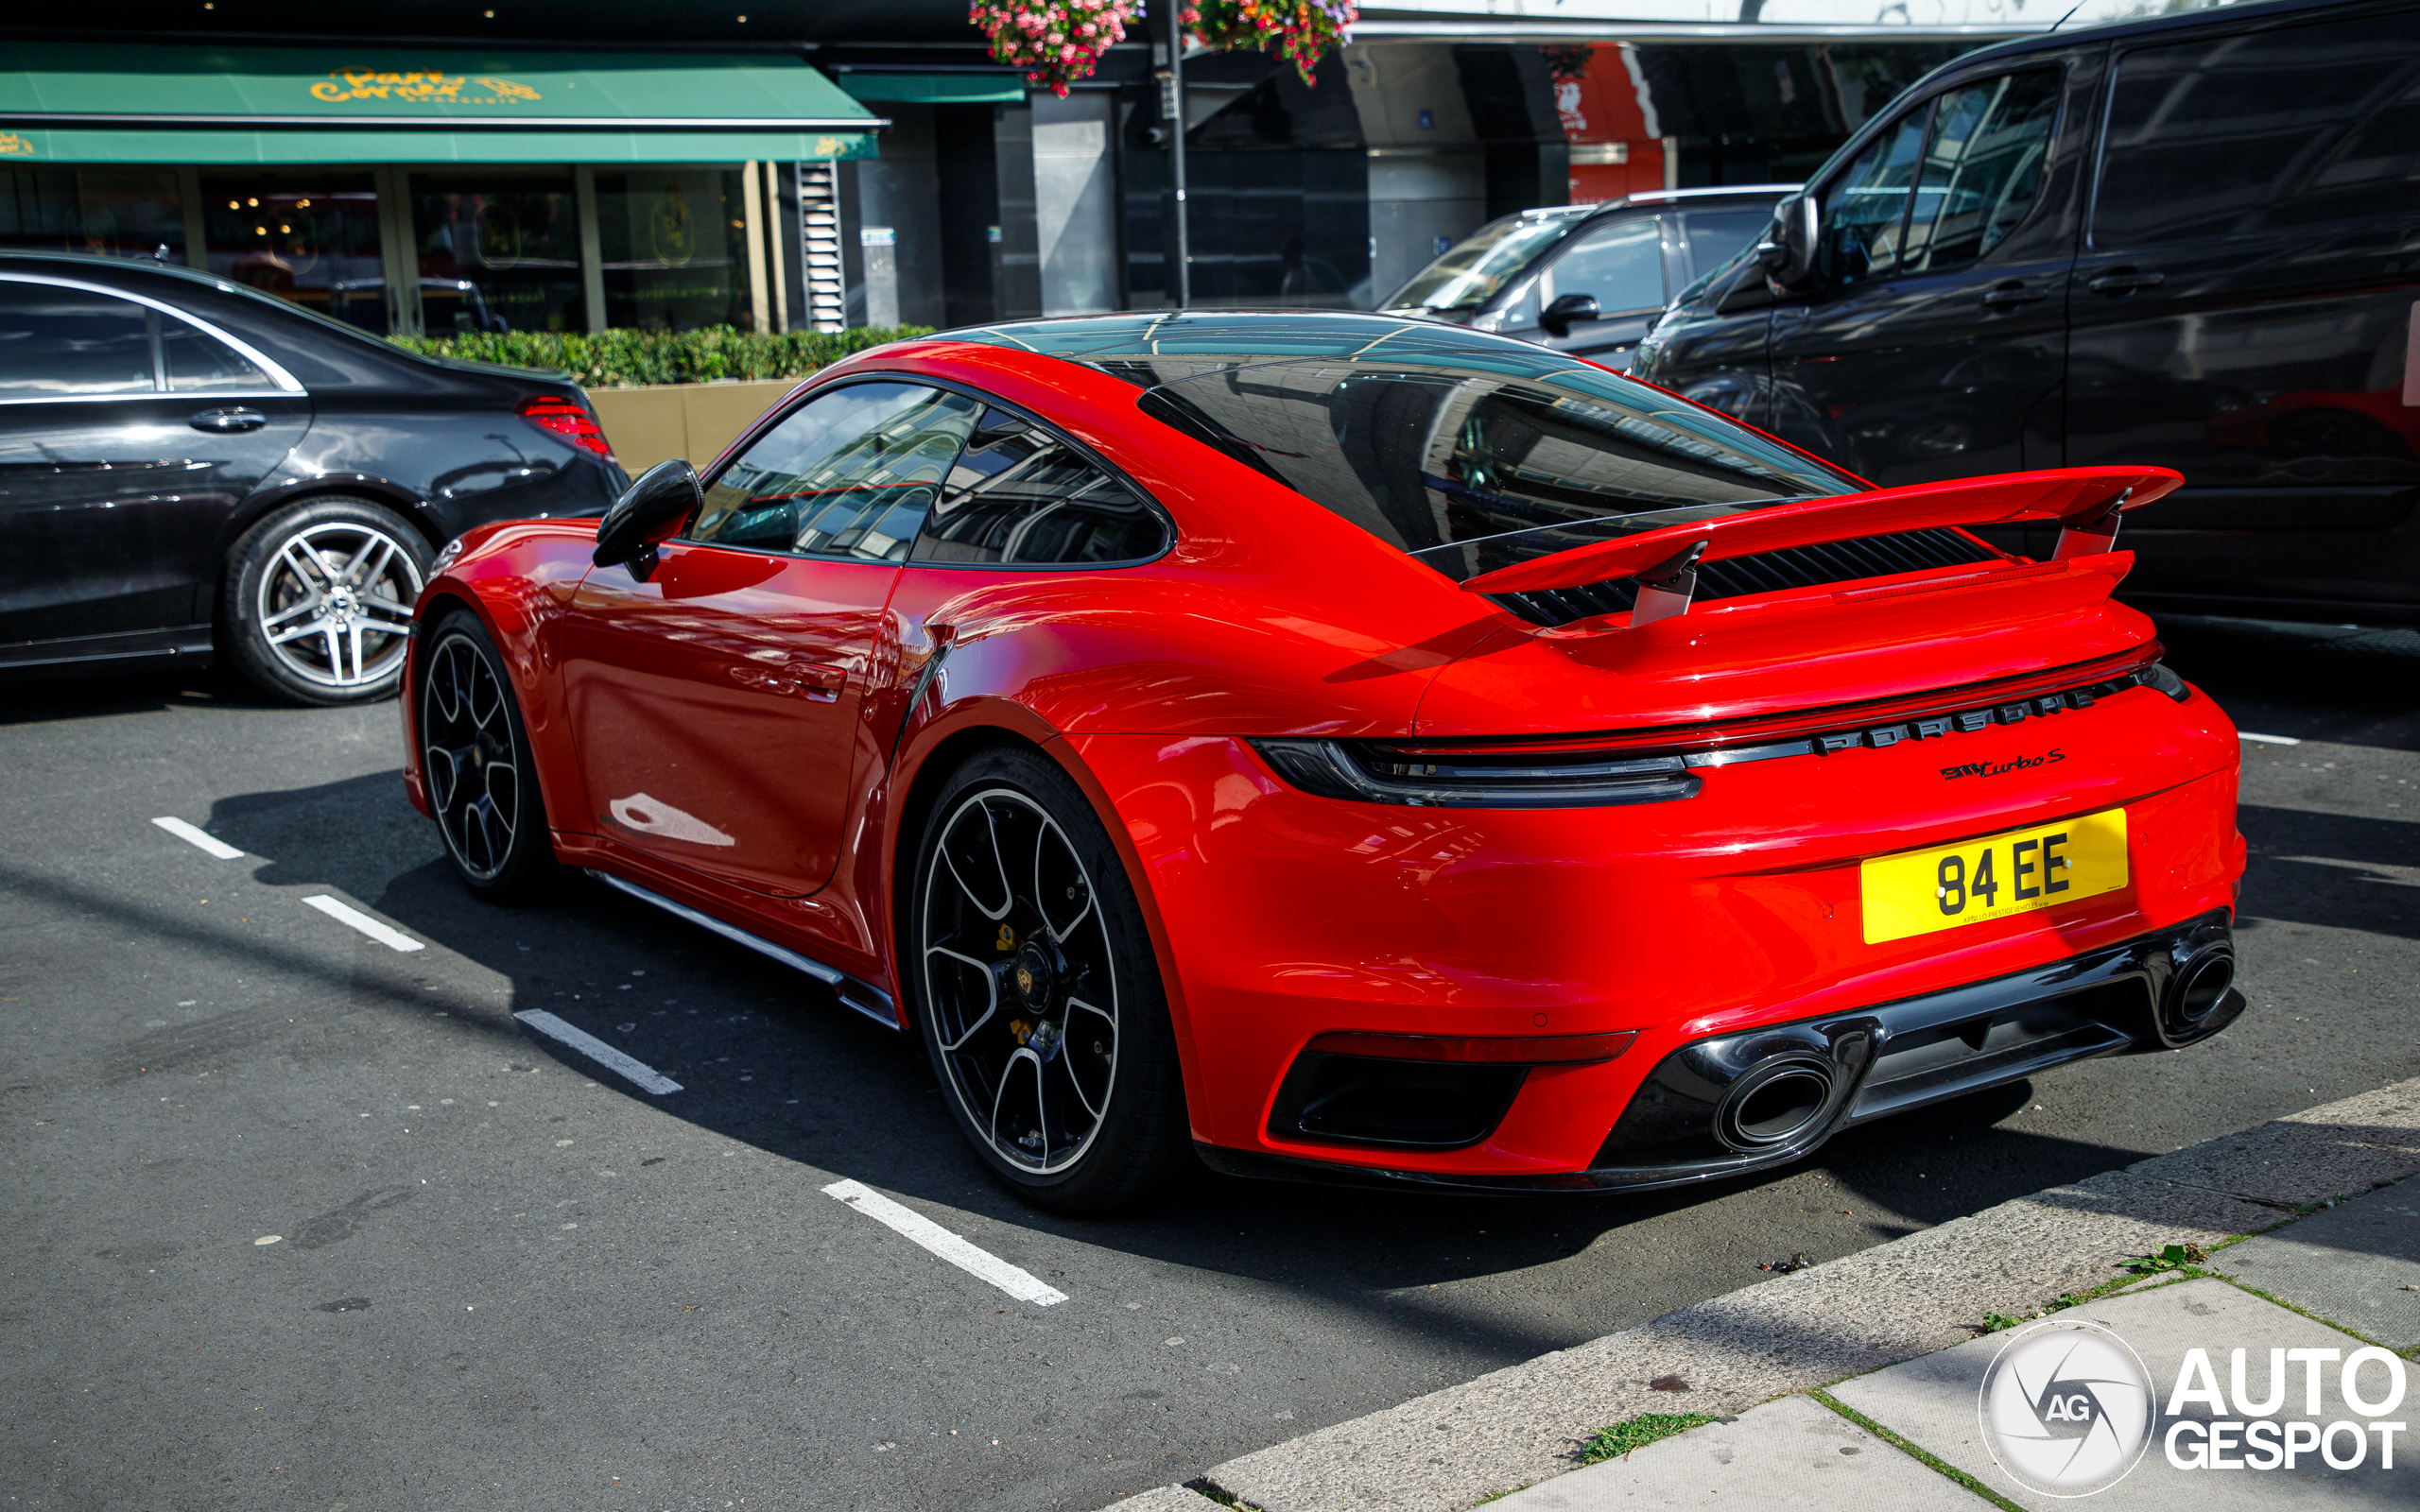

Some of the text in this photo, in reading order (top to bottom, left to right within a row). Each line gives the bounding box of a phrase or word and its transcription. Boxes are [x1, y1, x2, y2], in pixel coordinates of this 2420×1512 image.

[310, 81, 463, 103] Corner
[1810, 686, 2097, 757] PORSCHE
[1940, 763, 1981, 781] 911
[2047, 747, 2066, 765] S
[1938, 833, 2069, 916] 84 EE
[1963, 913, 1988, 924] APOLLO
[1988, 906, 2014, 919] PRESTIGE
[2014, 901, 2038, 914] VEHICLES
